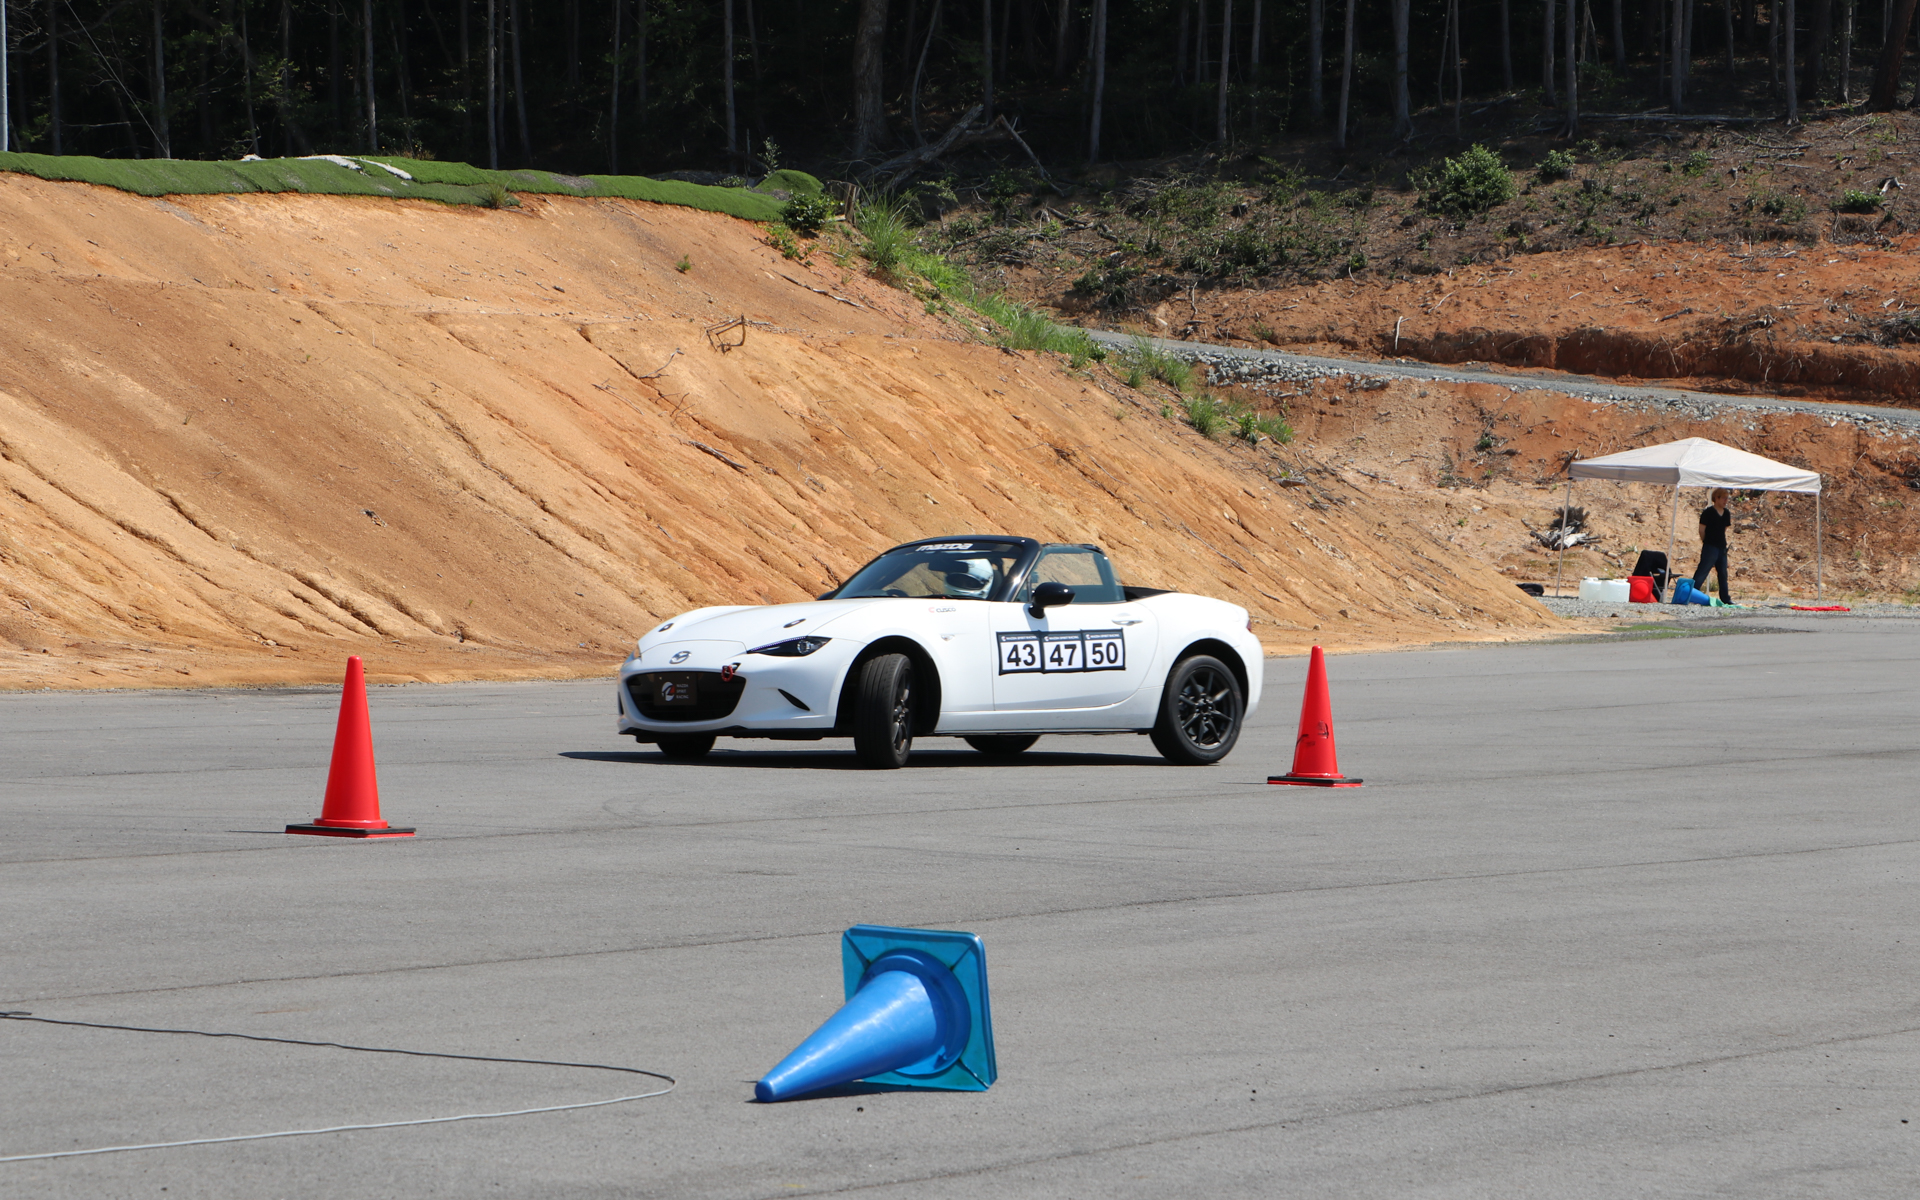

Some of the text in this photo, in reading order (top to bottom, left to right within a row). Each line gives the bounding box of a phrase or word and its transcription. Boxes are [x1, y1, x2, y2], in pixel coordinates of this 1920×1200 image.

[1007, 643, 1036, 667] 43
[1050, 643, 1077, 667] 47
[1092, 641, 1118, 665] 50
